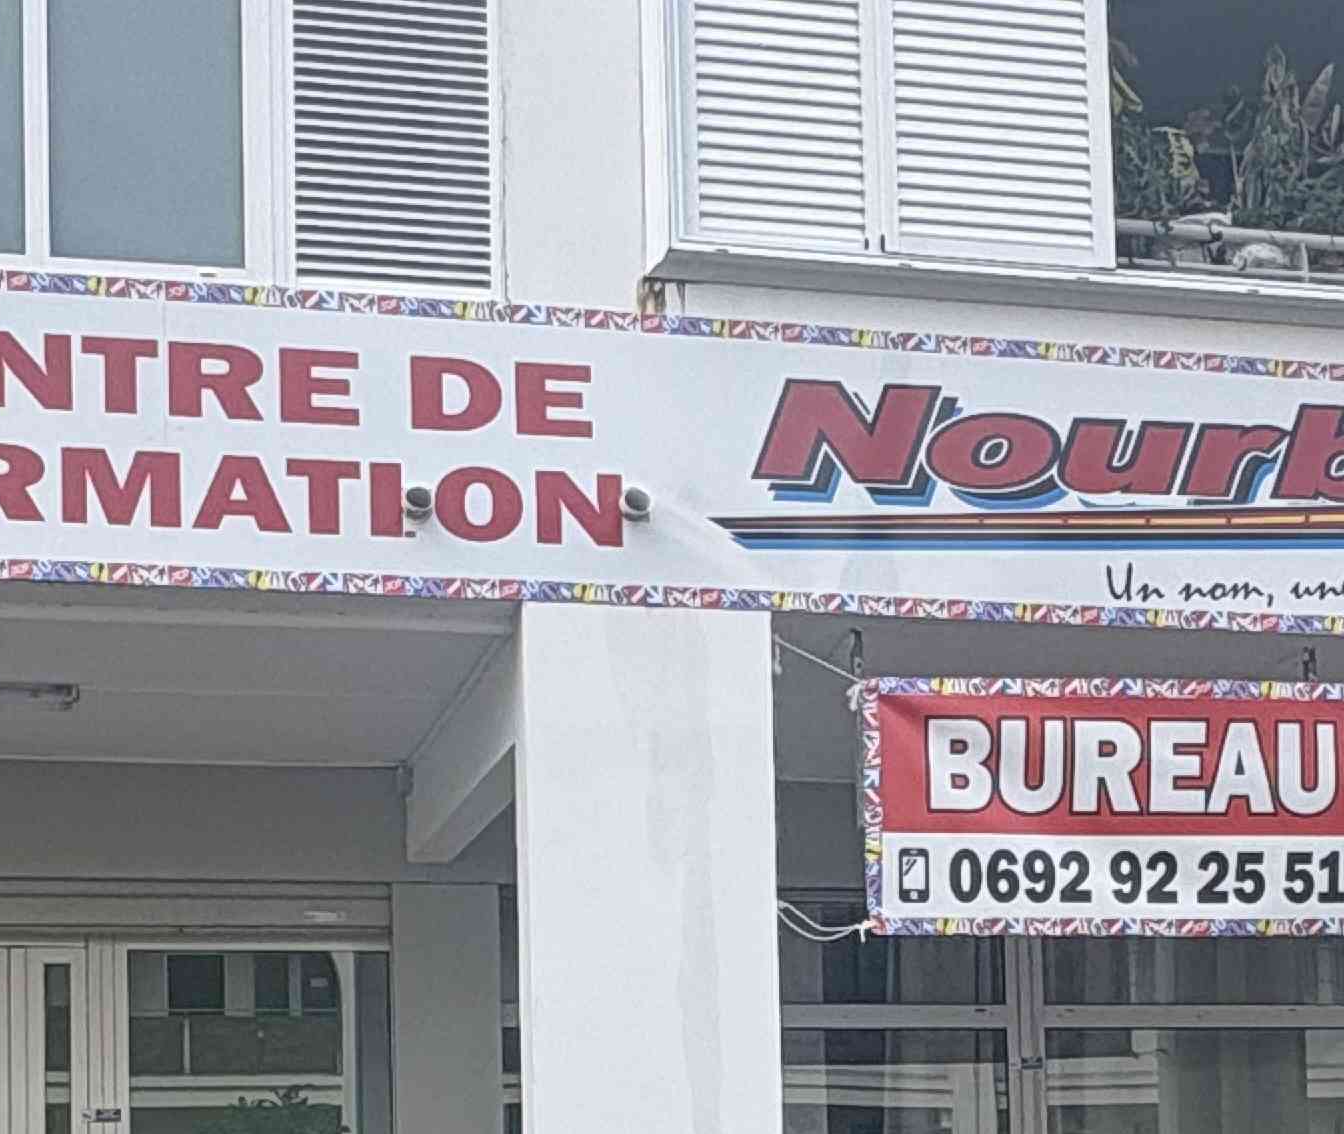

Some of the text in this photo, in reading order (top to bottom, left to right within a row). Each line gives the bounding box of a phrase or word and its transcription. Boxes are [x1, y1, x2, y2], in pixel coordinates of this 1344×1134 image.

[410, 355, 593, 439] DE
[1105, 562, 1166, 602] Un
[1174, 582, 1277, 608] nom,
[925, 715, 1339, 816] BUREAU
[949, 848, 1093, 904] 0692
[1109, 849, 1179, 904] 92
[1196, 850, 1266, 904] 25
